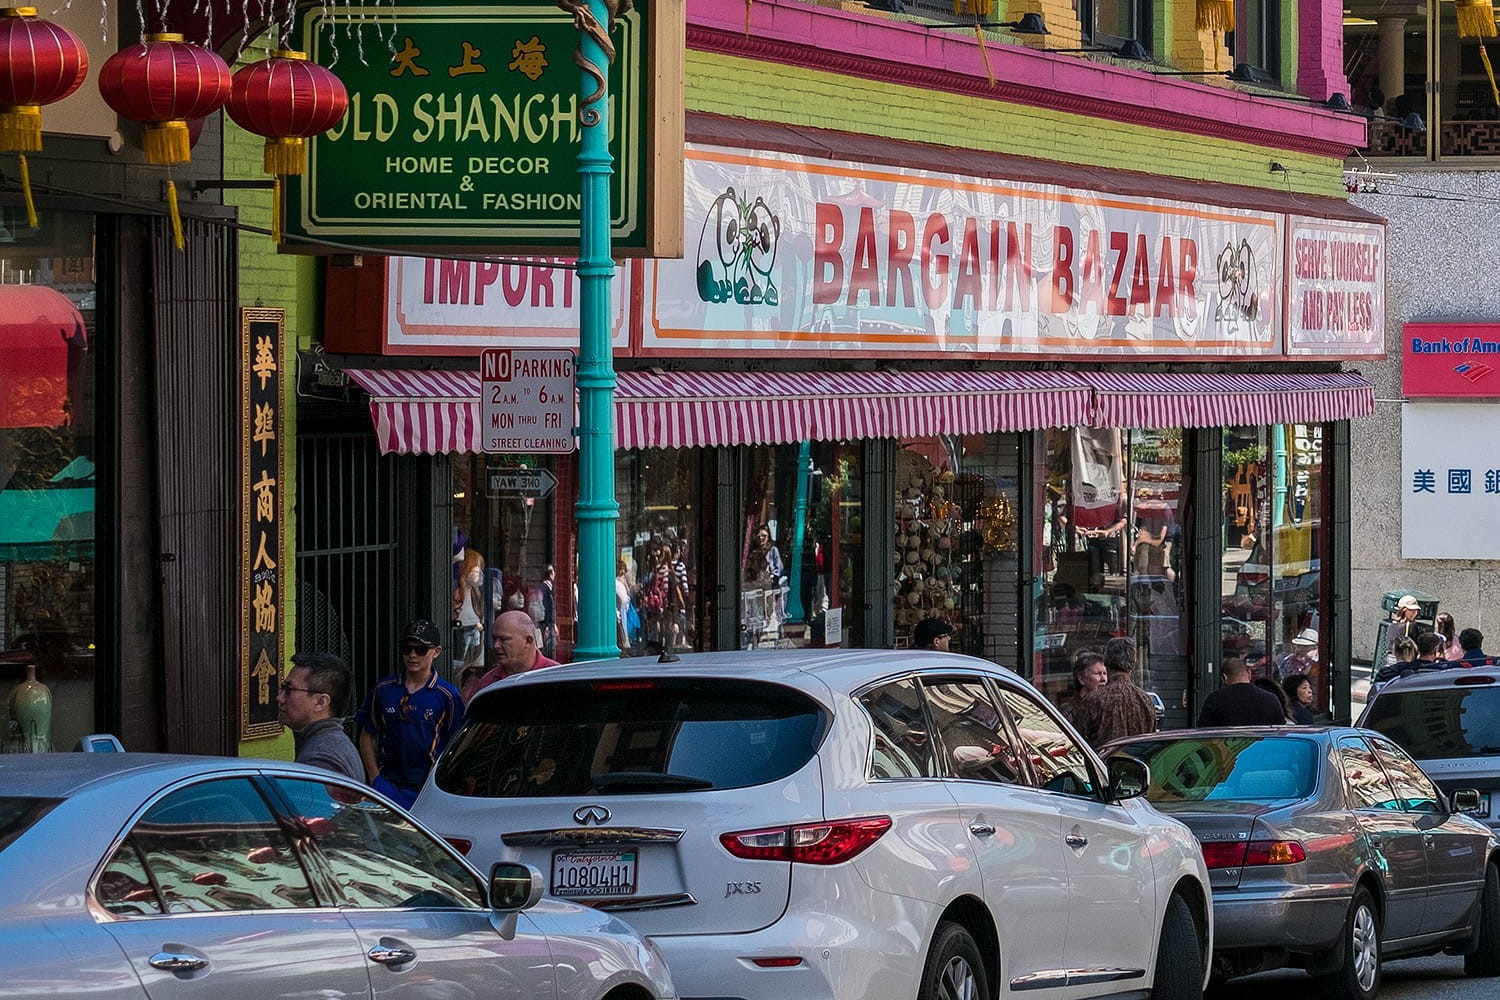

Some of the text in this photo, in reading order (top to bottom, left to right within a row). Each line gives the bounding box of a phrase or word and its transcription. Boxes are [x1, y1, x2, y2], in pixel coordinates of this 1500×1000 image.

[391, 37, 548, 80] 大上海
[412, 92, 615, 144] SHANGHI
[385, 157, 550, 175] HOME DECOR
[459, 175, 475, 192] &
[353, 192, 468, 211] ORIENTAL
[813, 202, 1199, 319] BARGAIN BAZAAR
[1295, 237, 1380, 282] SERVE YOURSELF
[1302, 290, 1323, 331] AND
[1411, 338, 1454, 354] Bank
[1454, 337, 1471, 354] of
[485, 353, 571, 378] NO PARKING
[523, 387, 531, 395] TO
[491, 412, 562, 429] MON THRU FRI
[491, 438, 567, 449] STREET CLEANING
[558, 865, 630, 888] 10804H1
[724, 880, 762, 899] JX35
